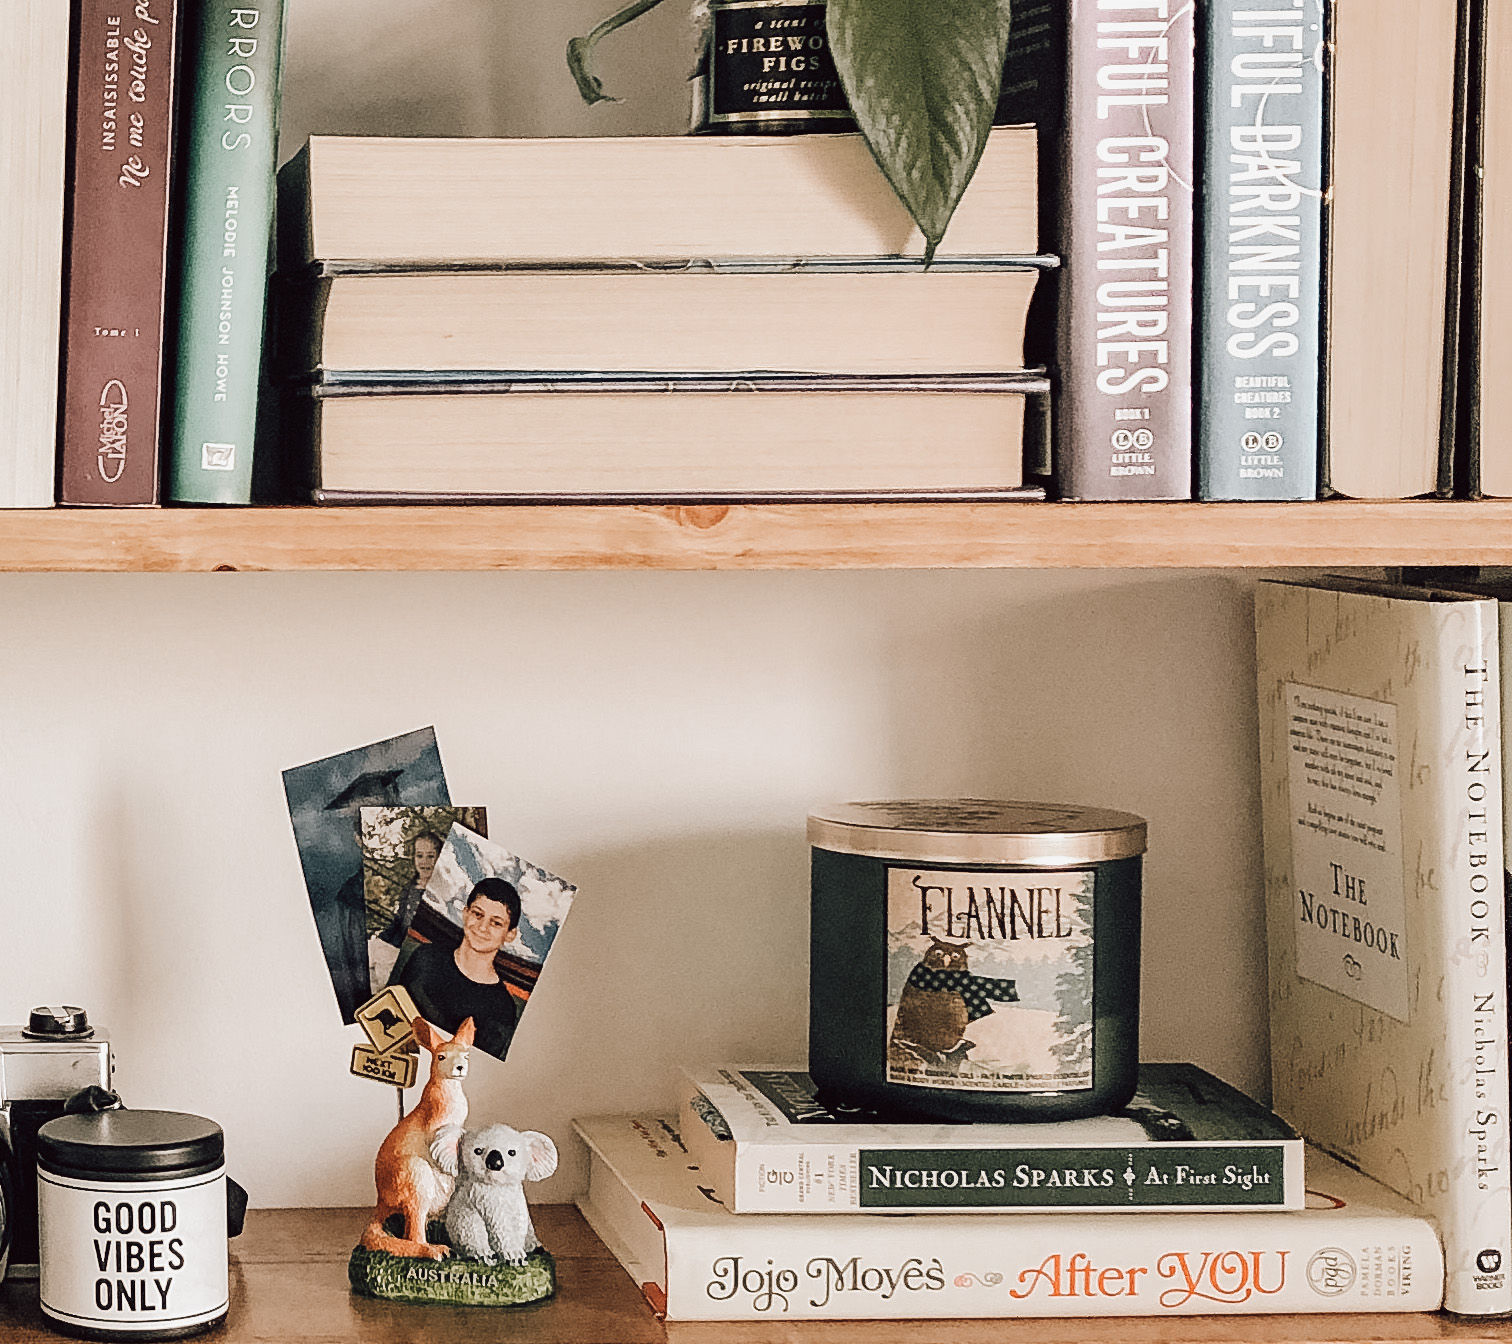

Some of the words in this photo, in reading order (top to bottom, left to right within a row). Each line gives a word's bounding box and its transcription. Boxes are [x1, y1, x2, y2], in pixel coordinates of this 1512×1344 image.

[102, 15, 120, 151] INSAISISSABLE
[223, 186, 240, 258] MELODIE
[1226, 124, 1302, 358] DARKNESS
[1096, 136, 1169, 395] CREATURES
[217, 267, 234, 345] JOHNSON
[214, 354, 229, 402] HOWE
[1464, 660, 1489, 732] THE
[912, 874, 1073, 940] FLANNEL
[1330, 861, 1368, 906] THE
[1473, 992, 1496, 1099] Nicholas
[1144, 1167, 1169, 1185] At
[1175, 1166, 1217, 1186] First
[1223, 1166, 1270, 1191] Sight
[1468, 1110, 1500, 1192] Sparks
[93, 1201, 177, 1235] GOOD
[94, 1238, 185, 1273] VIBES
[405, 1266, 498, 1288] AUSTRALIA
[706, 1256, 798, 1313] Jojo
[1009, 1252, 1148, 1299] After
[94, 1277, 173, 1312] ONLY
